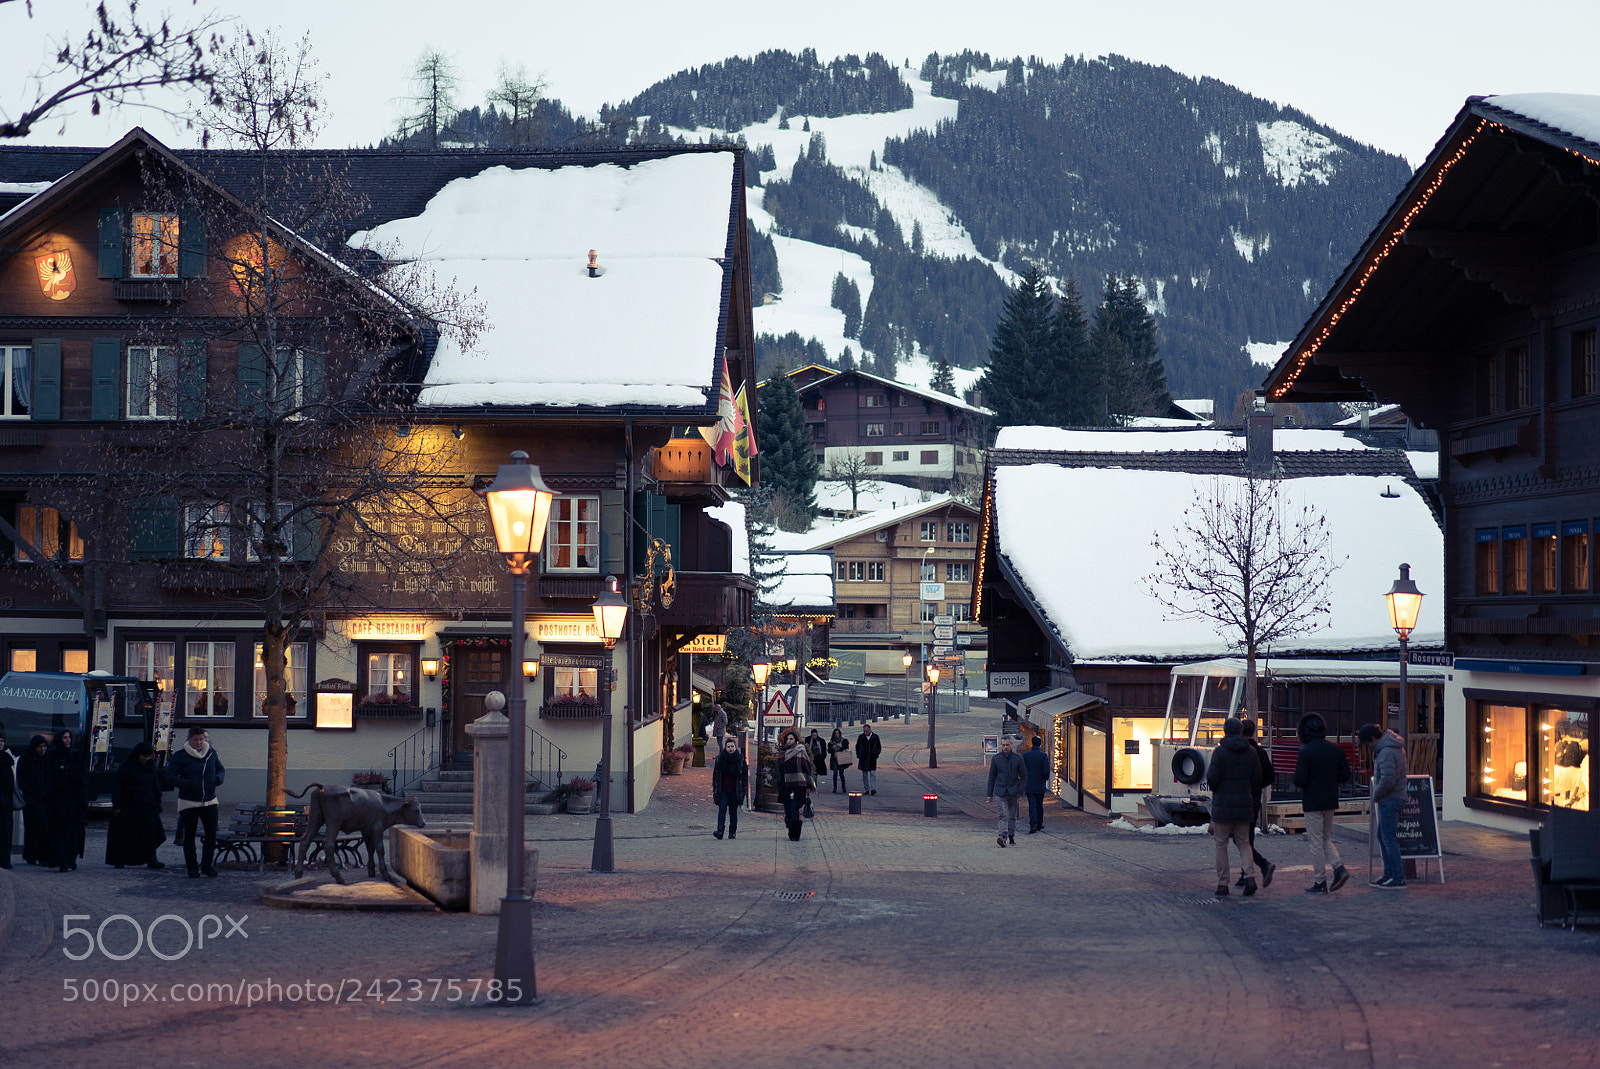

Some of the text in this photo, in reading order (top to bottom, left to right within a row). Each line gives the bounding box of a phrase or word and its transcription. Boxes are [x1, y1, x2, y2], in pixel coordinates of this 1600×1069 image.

[376, 622, 425, 635] RESTAURANT
[538, 624, 600, 637] POSTHOTEL RÖS
[688, 635, 719, 646] otel
[1412, 652, 1451, 666] Roseyweg
[993, 675, 1026, 687] simple
[1, 686, 76, 701] SAANERSLOCH
